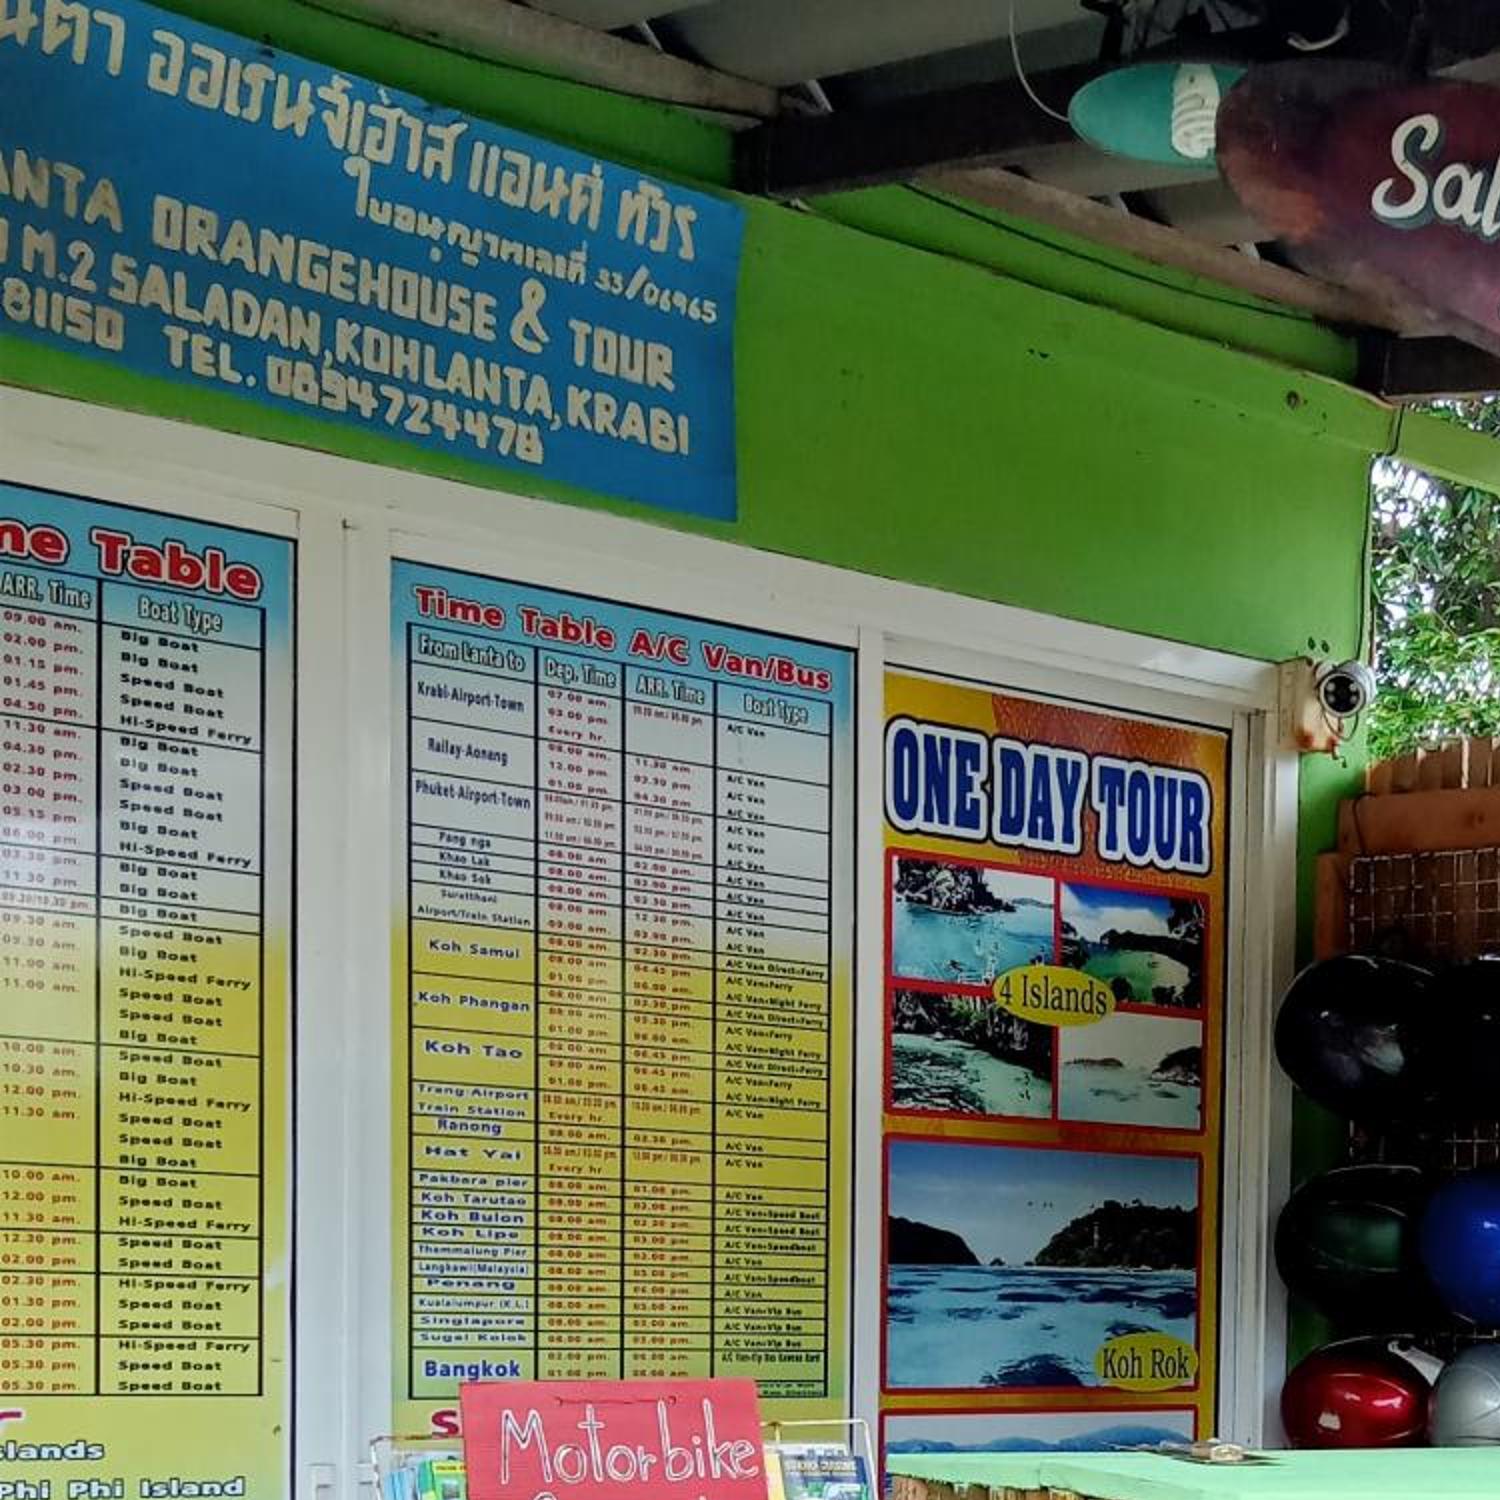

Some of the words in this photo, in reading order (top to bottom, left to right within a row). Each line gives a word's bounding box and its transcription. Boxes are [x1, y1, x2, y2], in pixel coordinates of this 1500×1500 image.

[153, 193, 498, 342] ORANGEHOUSE
[509, 278, 549, 354] &
[568, 319, 675, 392] TOUR
[3, 277, 125, 351] 81150
[163, 325, 256, 387] TEL.
[90, 527, 262, 600] Table
[1, 573, 43, 601] ARR.
[49, 580, 91, 609] Time
[138, 595, 179, 623] Boat
[184, 604, 224, 635] Type
[158, 635, 200, 653] Boat
[413, 585, 505, 630] Time
[516, 605, 616, 654] Table
[628, 628, 691, 666] A/C
[701, 640, 833, 692] Van/Bus
[120, 673, 176, 692] Speed
[183, 683, 225, 699] Boat
[419, 632, 459, 661] From
[461, 641, 505, 669] Lanta
[506, 650, 526, 673] to
[582, 663, 617, 689] Time
[672, 680, 705, 706] Time
[743, 693, 776, 717] Boat
[777, 698, 809, 726] Type
[120, 693, 176, 713] Speed
[183, 703, 225, 719] Boat
[207, 727, 252, 745] Ferry
[889, 722, 986, 836] ONE
[995, 741, 1086, 850] DAY
[1095, 760, 1208, 870] TOUR
[998, 977, 1013, 1005] 4
[1021, 969, 1108, 1015] Islands
[424, 1039, 471, 1055] Koh
[482, 1044, 524, 1059] Tao
[424, 1360, 521, 1381] Bangkok
[1103, 1348, 1143, 1379] Koh
[1150, 1348, 1190, 1379] Rok
[117, 1379, 174, 1393] Speed
[181, 1379, 223, 1392] Boat
[500, 1398, 760, 1485] Motorbike
[67, 1478, 124, 1500] Phi
[139, 1476, 246, 1498] Island
